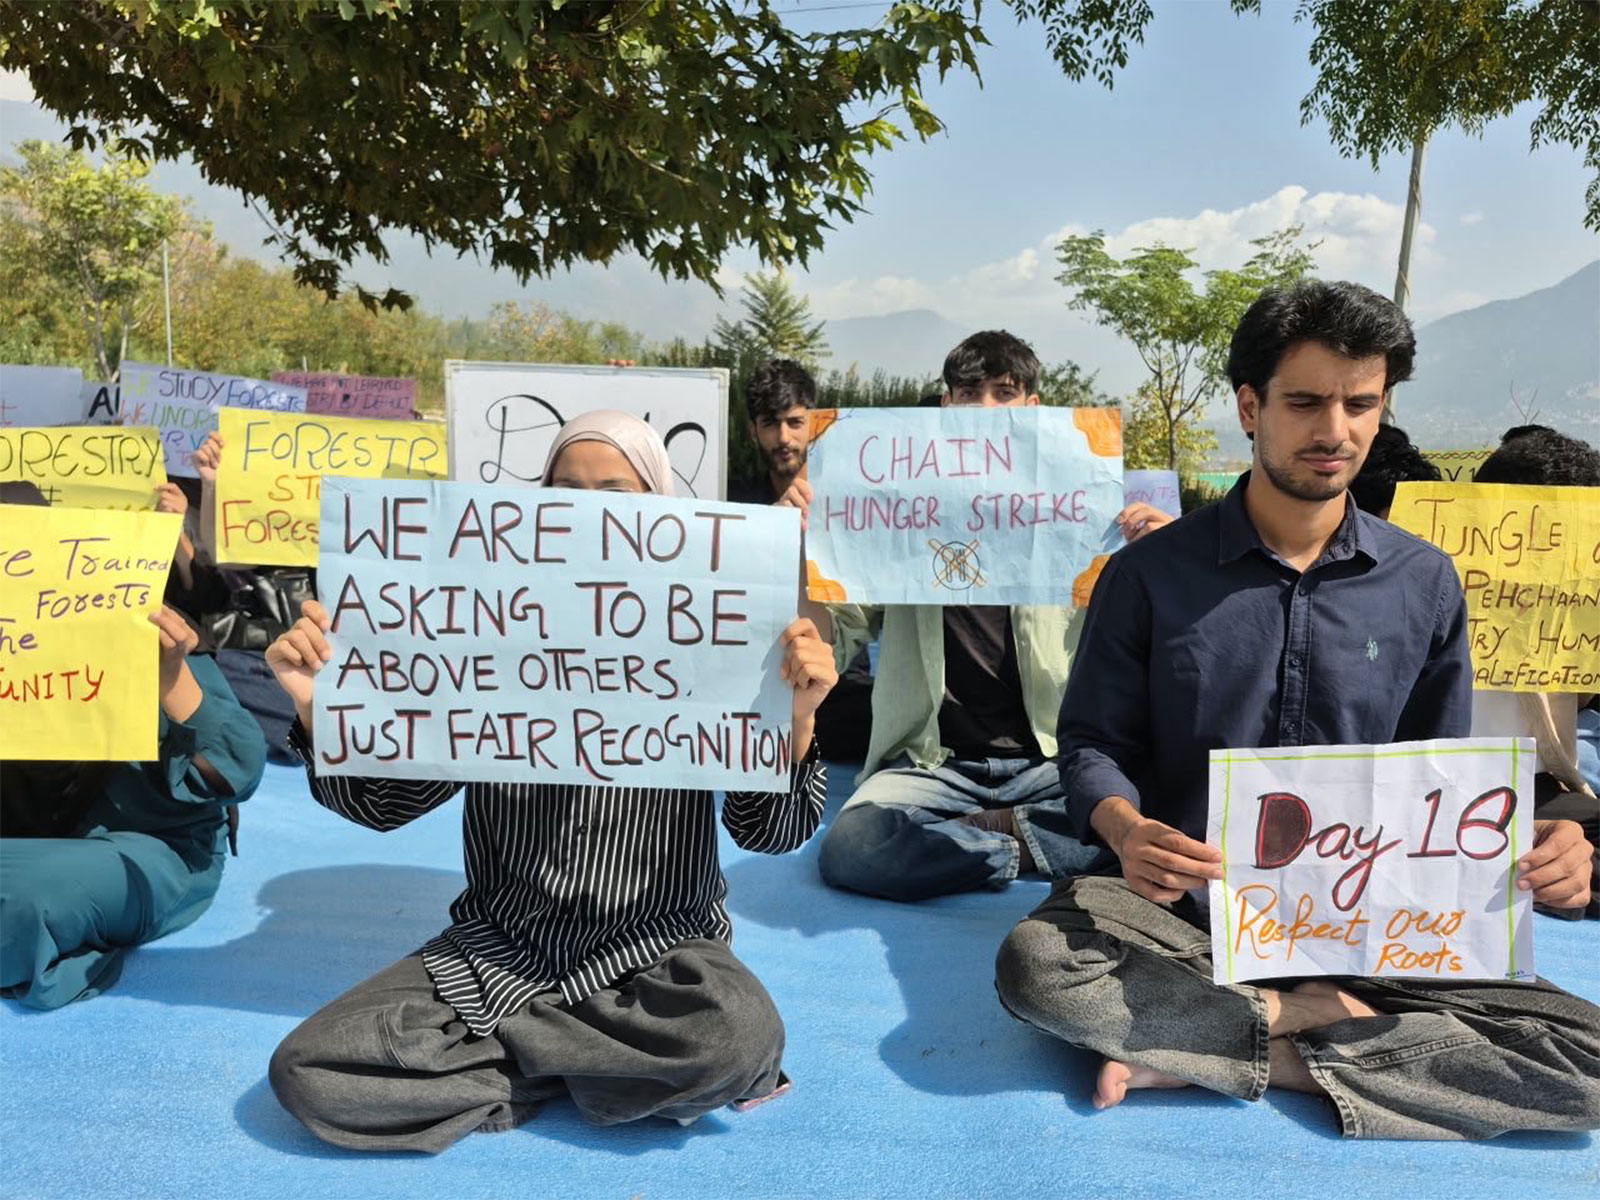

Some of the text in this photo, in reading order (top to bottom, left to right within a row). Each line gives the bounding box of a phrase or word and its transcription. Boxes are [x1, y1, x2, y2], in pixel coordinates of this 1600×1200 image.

[159, 370, 225, 405] STUDY
[859, 435, 1013, 484] CHAIN
[344, 492, 747, 573] WE ARE NOT
[824, 490, 1089, 532] HUNGER STRIKE
[59, 537, 169, 580] Trained
[331, 574, 749, 646] ASKING TO BE
[336, 646, 500, 696] ABOVE
[321, 703, 433, 766] JUST
[448, 708, 558, 770] FAIR
[1250, 792, 1403, 912] Day
[1234, 884, 1371, 961] Respect
